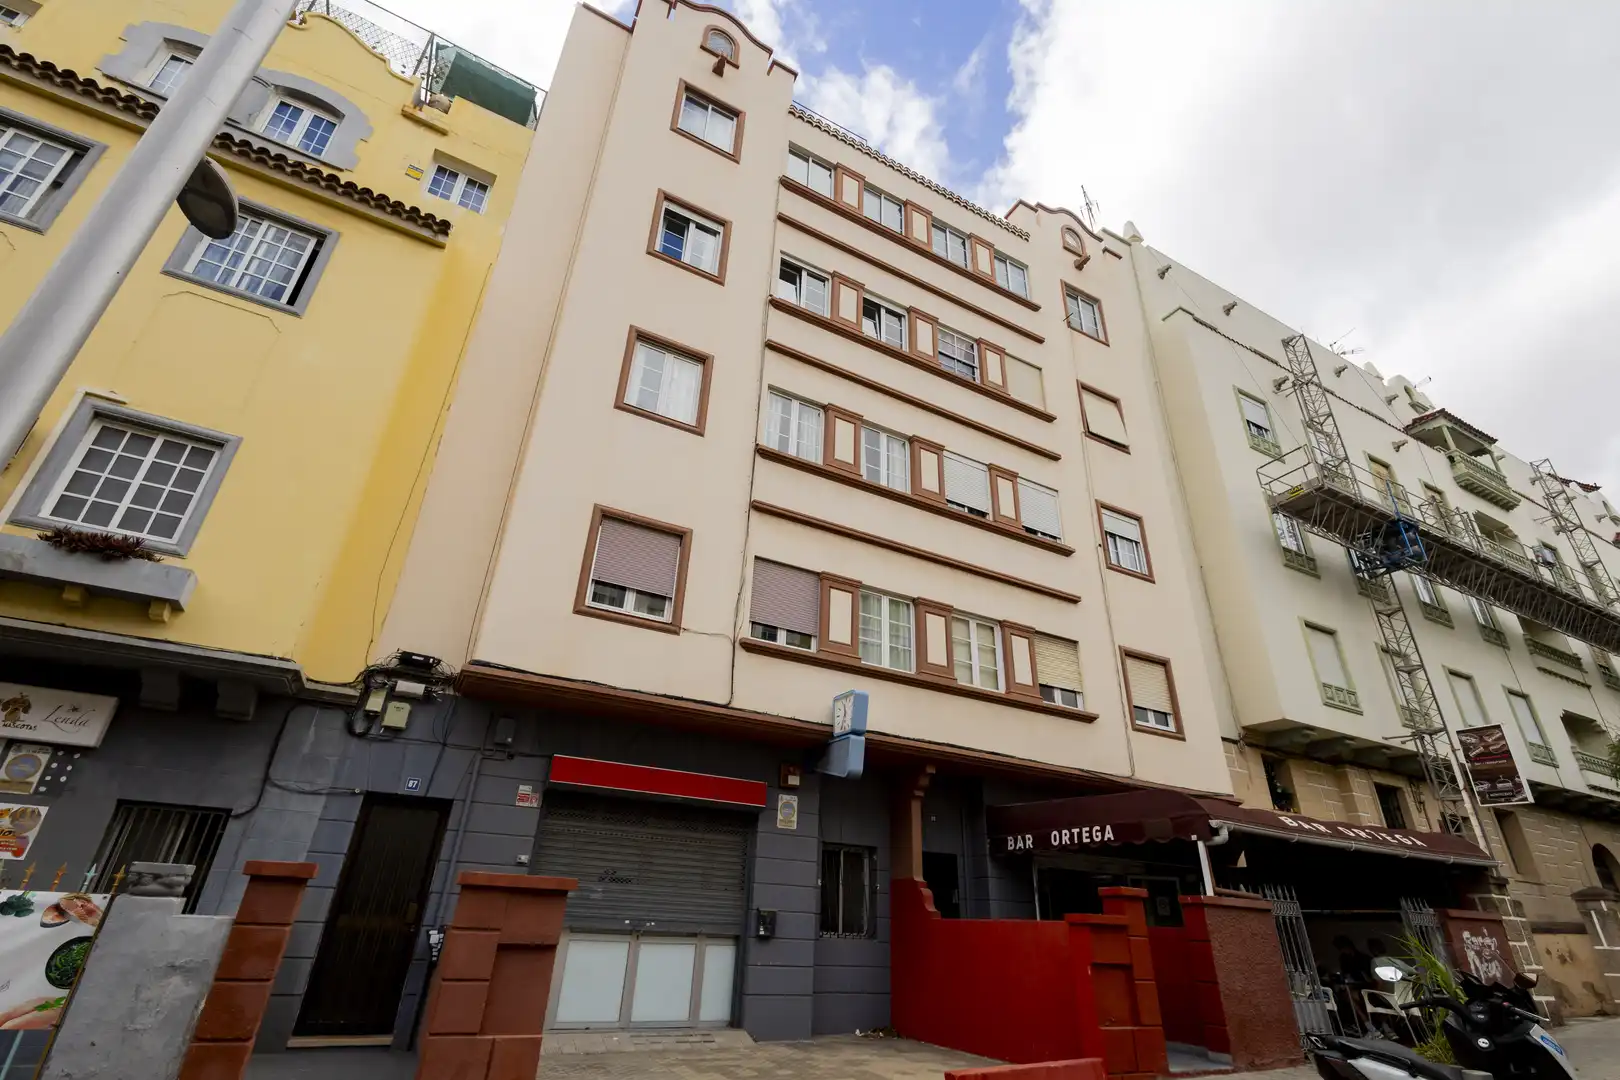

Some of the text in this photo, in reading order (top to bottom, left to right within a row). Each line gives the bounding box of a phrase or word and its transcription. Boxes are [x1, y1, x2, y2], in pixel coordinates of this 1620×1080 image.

[1007, 824, 1115, 851] BAR ORTEGA
[1277, 815, 1428, 848] BAR ORTEGA
